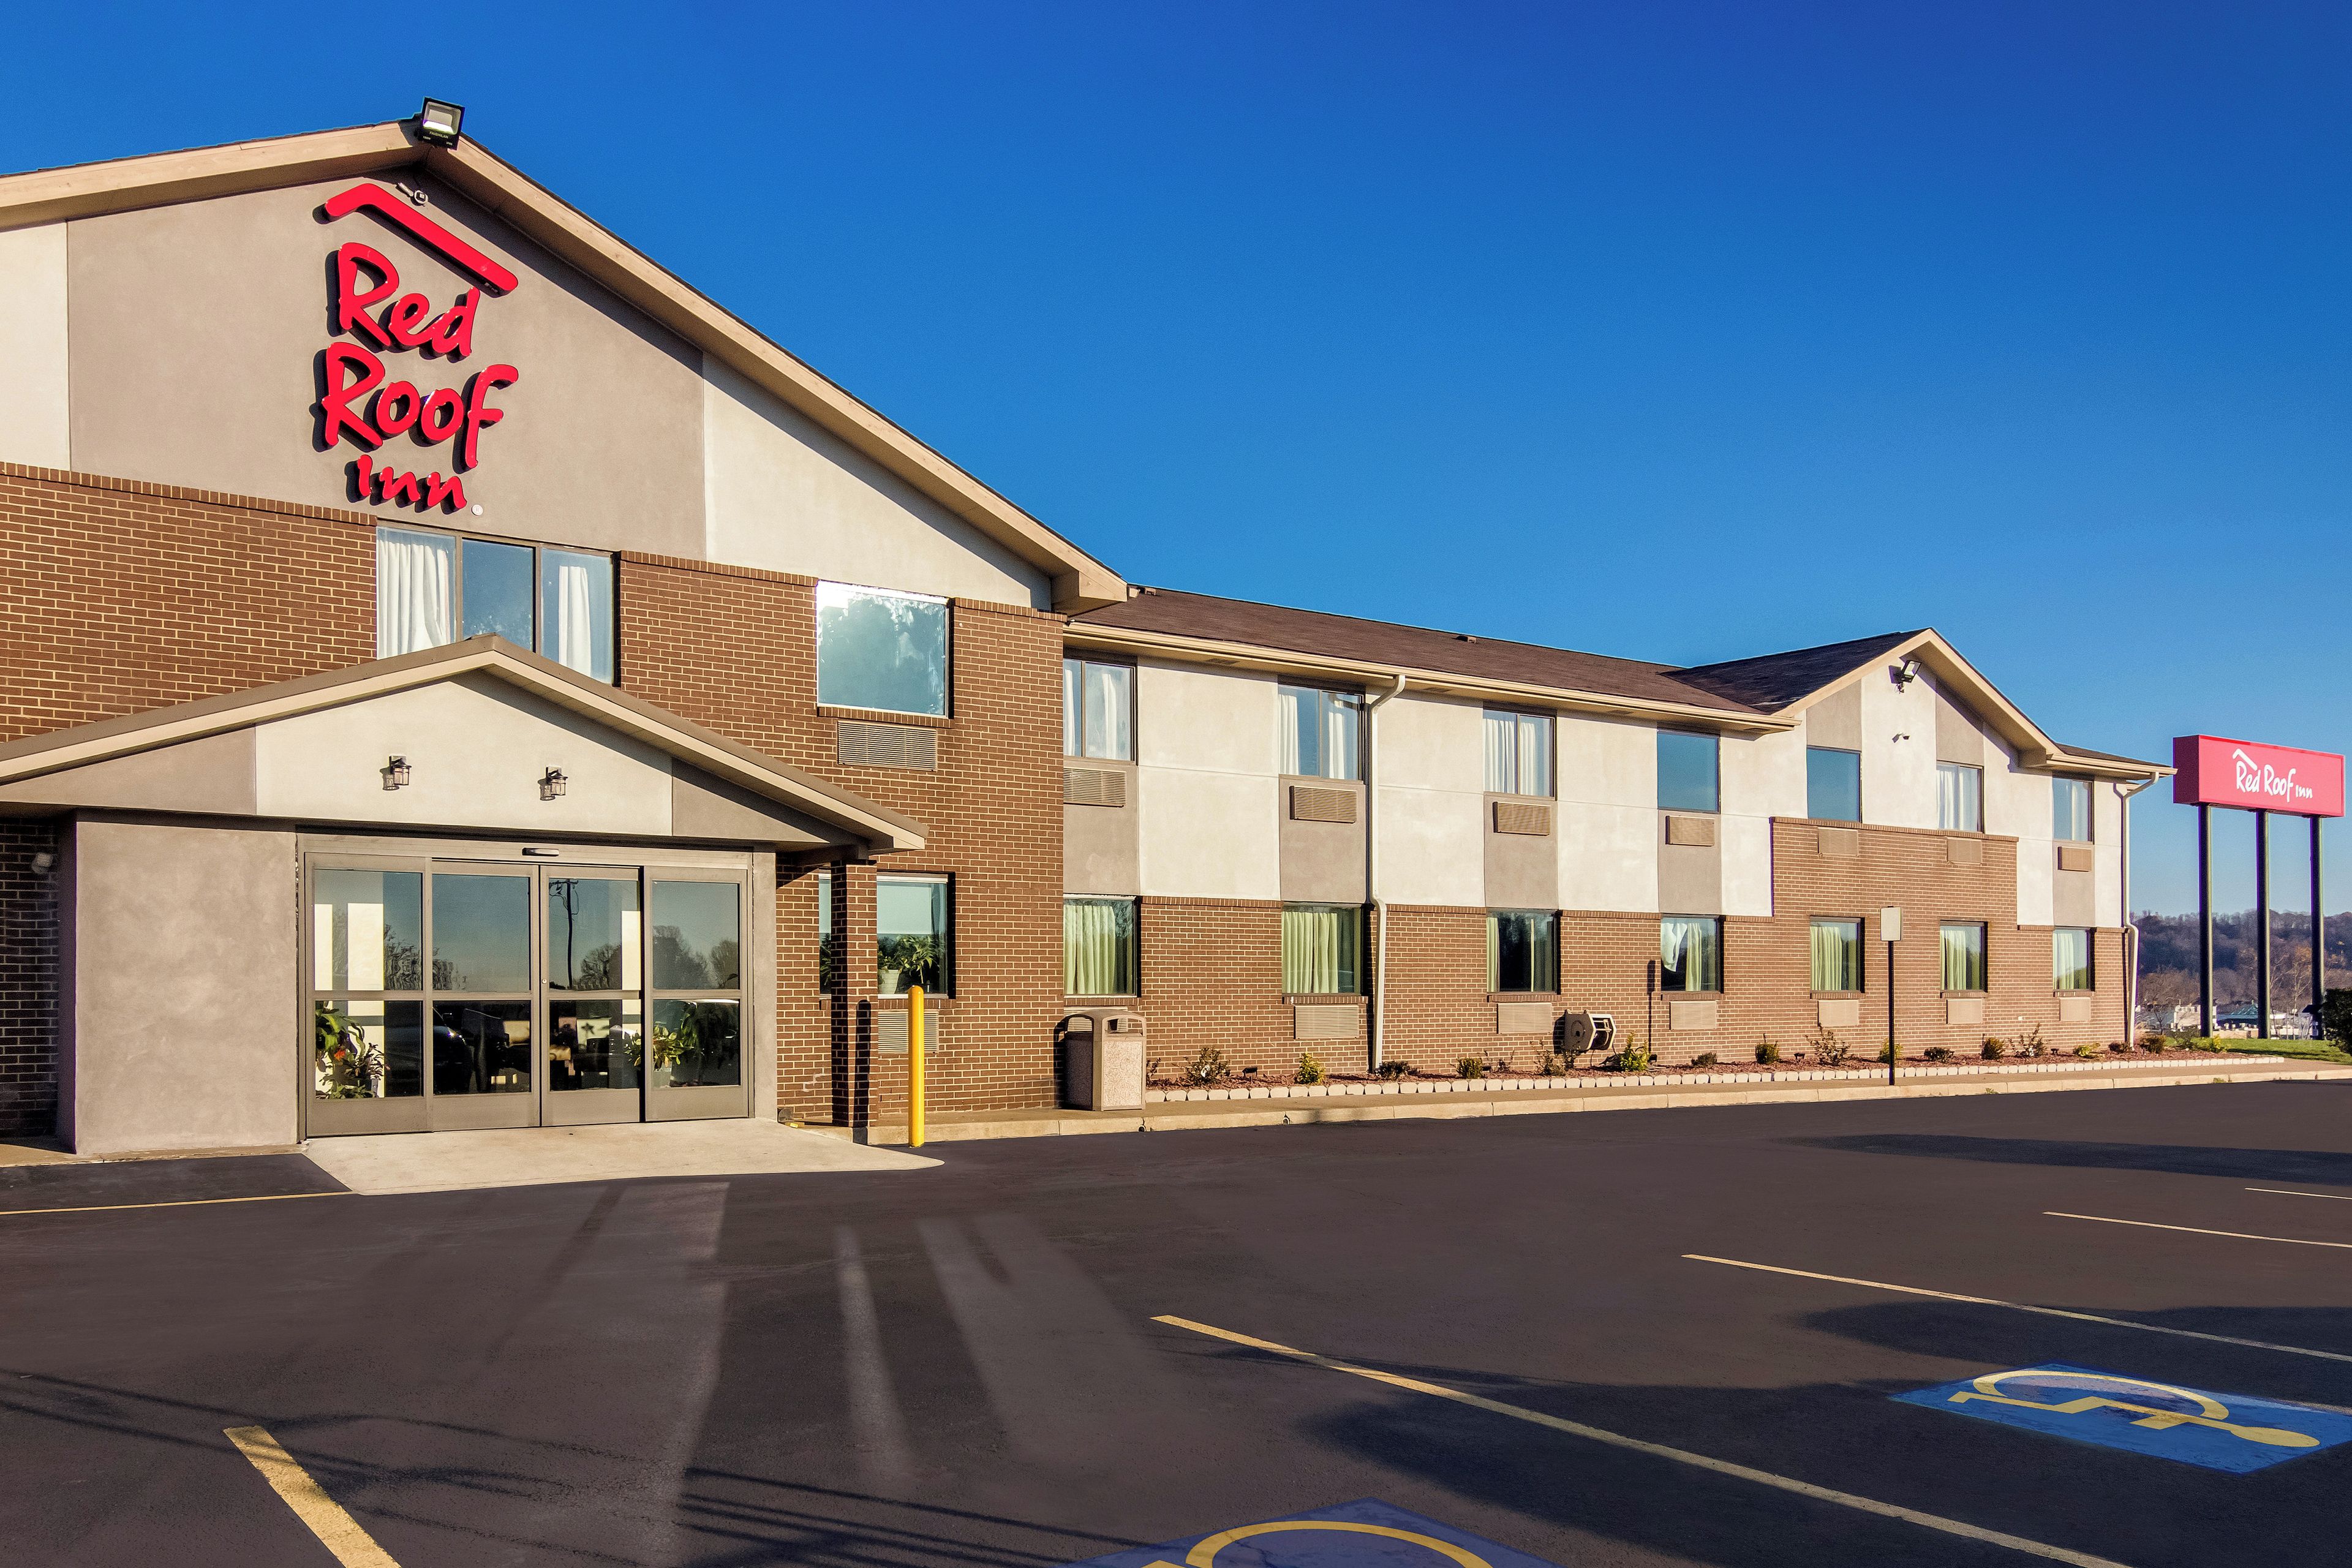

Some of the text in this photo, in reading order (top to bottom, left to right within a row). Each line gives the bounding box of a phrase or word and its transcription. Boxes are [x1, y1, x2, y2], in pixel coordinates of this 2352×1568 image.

[337, 242, 480, 356] Red
[322, 342, 519, 469] Roof
[358, 454, 467, 509] Inn
[2236, 761, 2313, 802] Red Roof Inn
